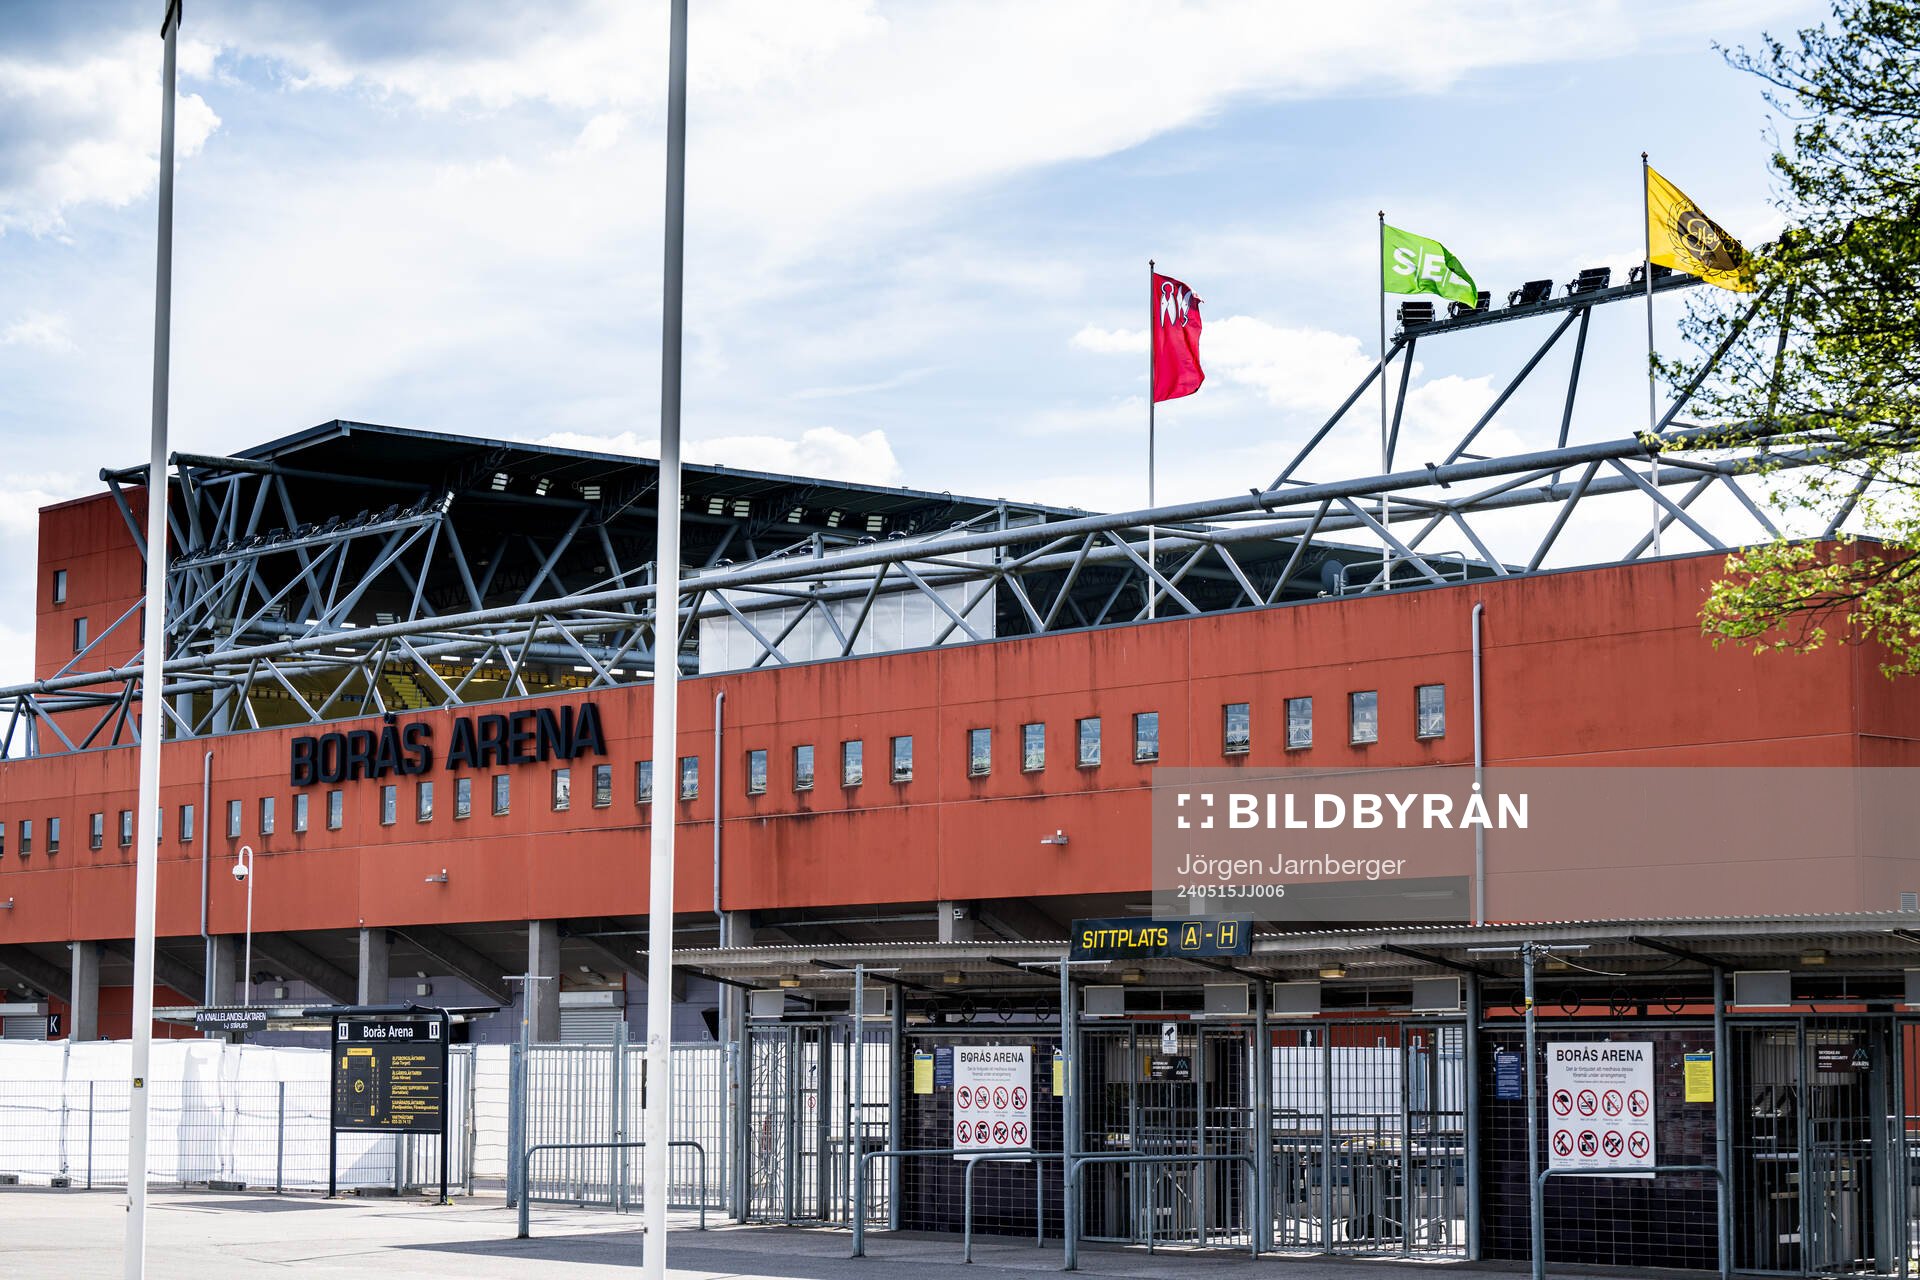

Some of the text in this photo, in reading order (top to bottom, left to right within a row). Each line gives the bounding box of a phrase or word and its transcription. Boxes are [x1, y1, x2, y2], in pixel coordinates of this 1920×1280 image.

[291, 702, 607, 787] BORÅS ARENA
[1082, 927, 1169, 949] SITTPLATS
[1184, 927, 1197, 945] A
[1220, 925, 1234, 944] H
[50, 1015, 58, 1033] K
[363, 1024, 386, 1038] Borås
[388, 1025, 414, 1038] Arena
[960, 1049, 1024, 1063] BORÅS ARENA
[1556, 1046, 1643, 1062] BORÅS ARENA
